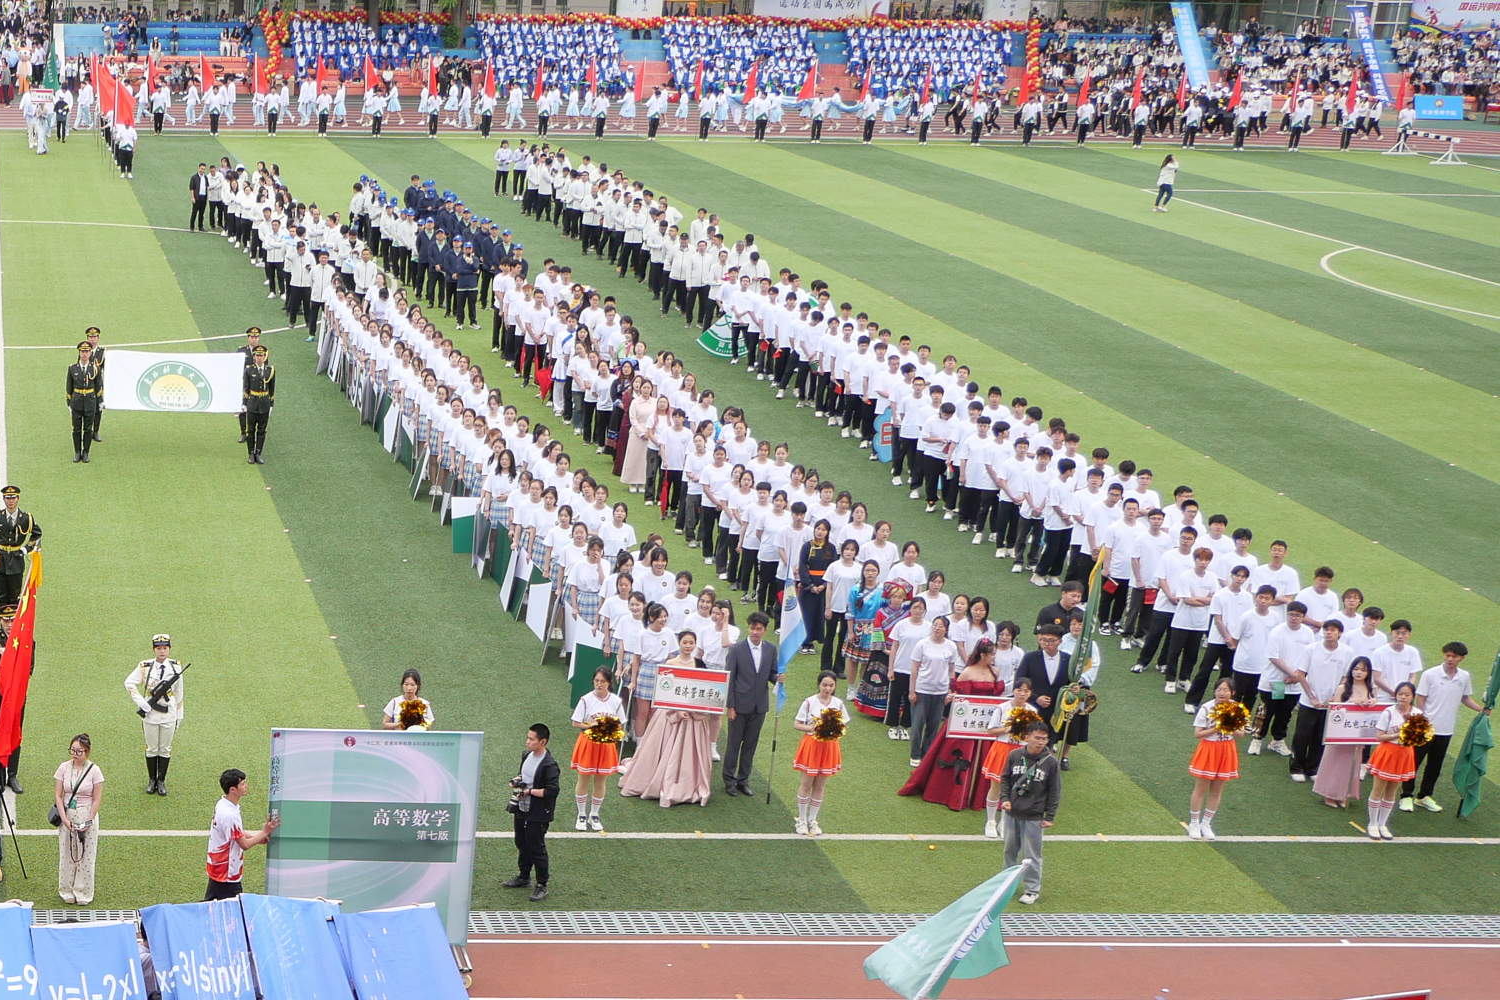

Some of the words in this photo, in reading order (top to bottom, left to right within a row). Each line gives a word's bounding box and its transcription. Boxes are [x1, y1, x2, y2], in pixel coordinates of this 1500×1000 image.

[674, 686, 722, 701] 经济管理学院
[271, 756, 280, 796] 高等数学
[373, 808, 450, 828] 高等数学
[416, 830, 449, 841] 第七版
